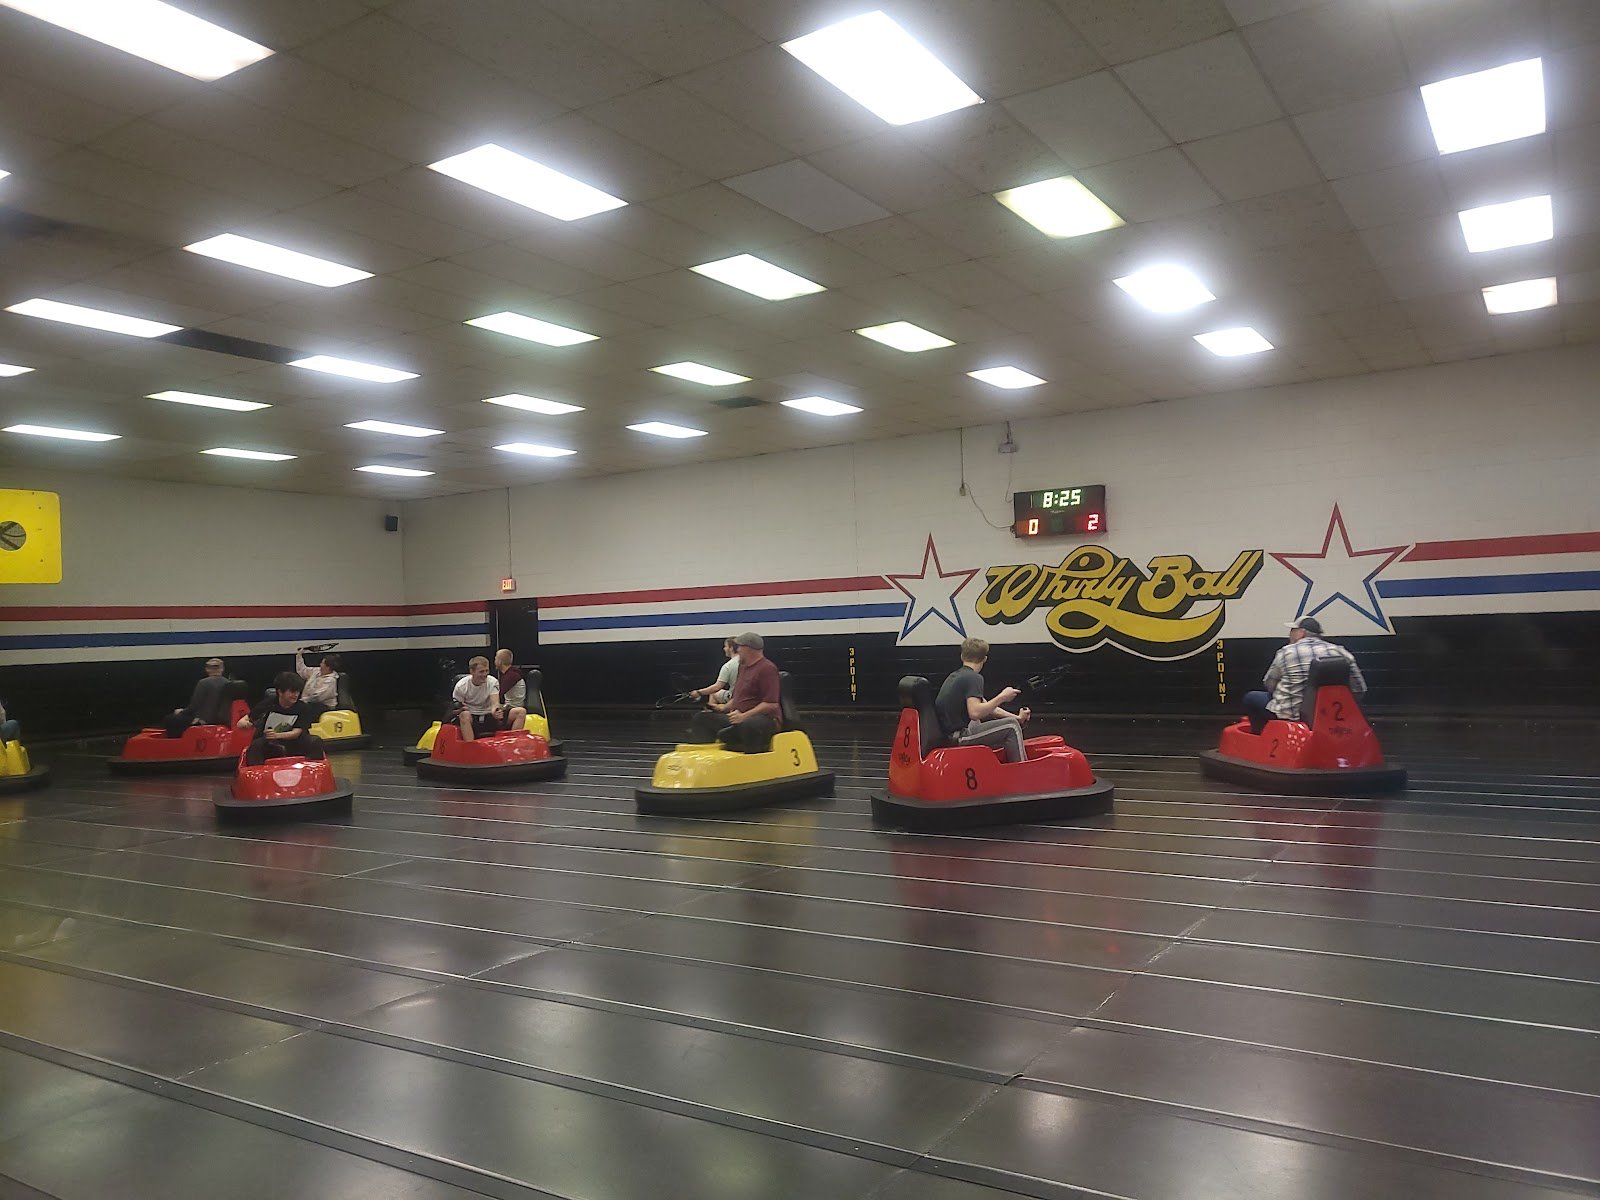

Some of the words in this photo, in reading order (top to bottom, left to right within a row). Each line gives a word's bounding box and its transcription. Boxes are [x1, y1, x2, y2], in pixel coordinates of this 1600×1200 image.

[1042, 489, 1081, 508] 8:25
[1028, 518, 1039, 535] 0
[1087, 513, 1099, 530] 2
[1137, 549, 1264, 618] Ball
[849, 647, 855, 656] 3
[1216, 639, 1224, 650] 3
[849, 657, 857, 702] POINT
[1216, 651, 1227, 704] POINT
[1332, 701, 1344, 721] 2
[904, 726, 911, 748] 8
[790, 748, 801, 767] 3
[1269, 738, 1279, 758] 2
[965, 767, 978, 790] 8
